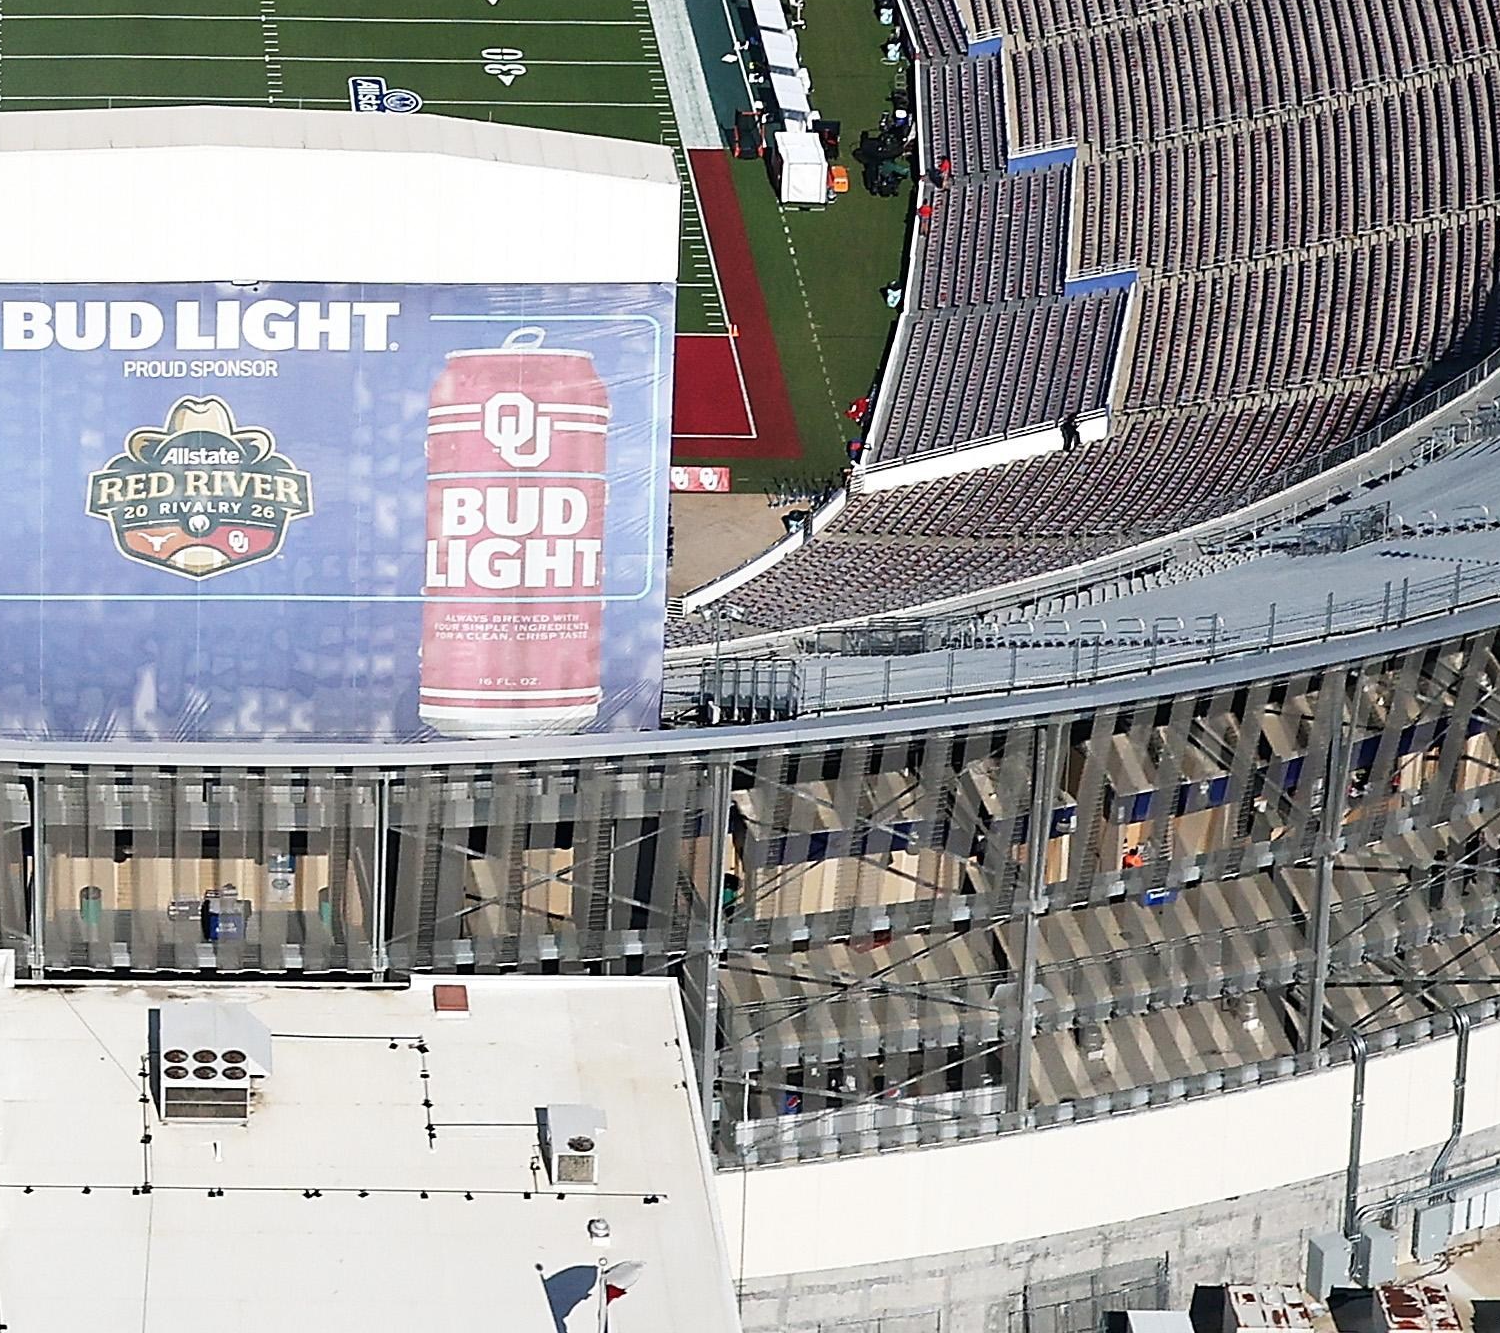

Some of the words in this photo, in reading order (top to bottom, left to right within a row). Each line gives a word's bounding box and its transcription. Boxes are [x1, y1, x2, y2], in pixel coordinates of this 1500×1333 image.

[481, 48, 526, 77] 30
[2, 300, 163, 350] BUD
[176, 299, 400, 351] LIGHT
[123, 361, 187, 377] PROUD
[190, 361, 278, 377] SPONSOR
[484, 391, 551, 468] OU
[161, 447, 239, 465] Allstate
[96, 472, 174, 505] RED
[185, 471, 303, 505] RIVER
[699, 467, 717, 490] OU
[123, 505, 149, 519] 20
[160, 502, 242, 516] RIVALRY
[251, 504, 276, 519] 26
[441, 486, 588, 536] BUD
[228, 530, 249, 553] OU
[426, 538, 600, 589] LIGHT
[434, 622, 459, 631] FOUR
[462, 622, 509, 632] SIMPLE
[514, 622, 589, 632] INGREDIENTS
[445, 613, 489, 623] ALWAYS
[492, 614, 550, 623] BREWED
[553, 613, 580, 623] WITH
[435, 631, 454, 640] FOR
[516, 631, 557, 641] CRISP
[560, 631, 588, 640] TASTE
[479, 677, 492, 686] 16
[496, 677, 517, 686] FL.
[520, 677, 541, 686] OZ.
